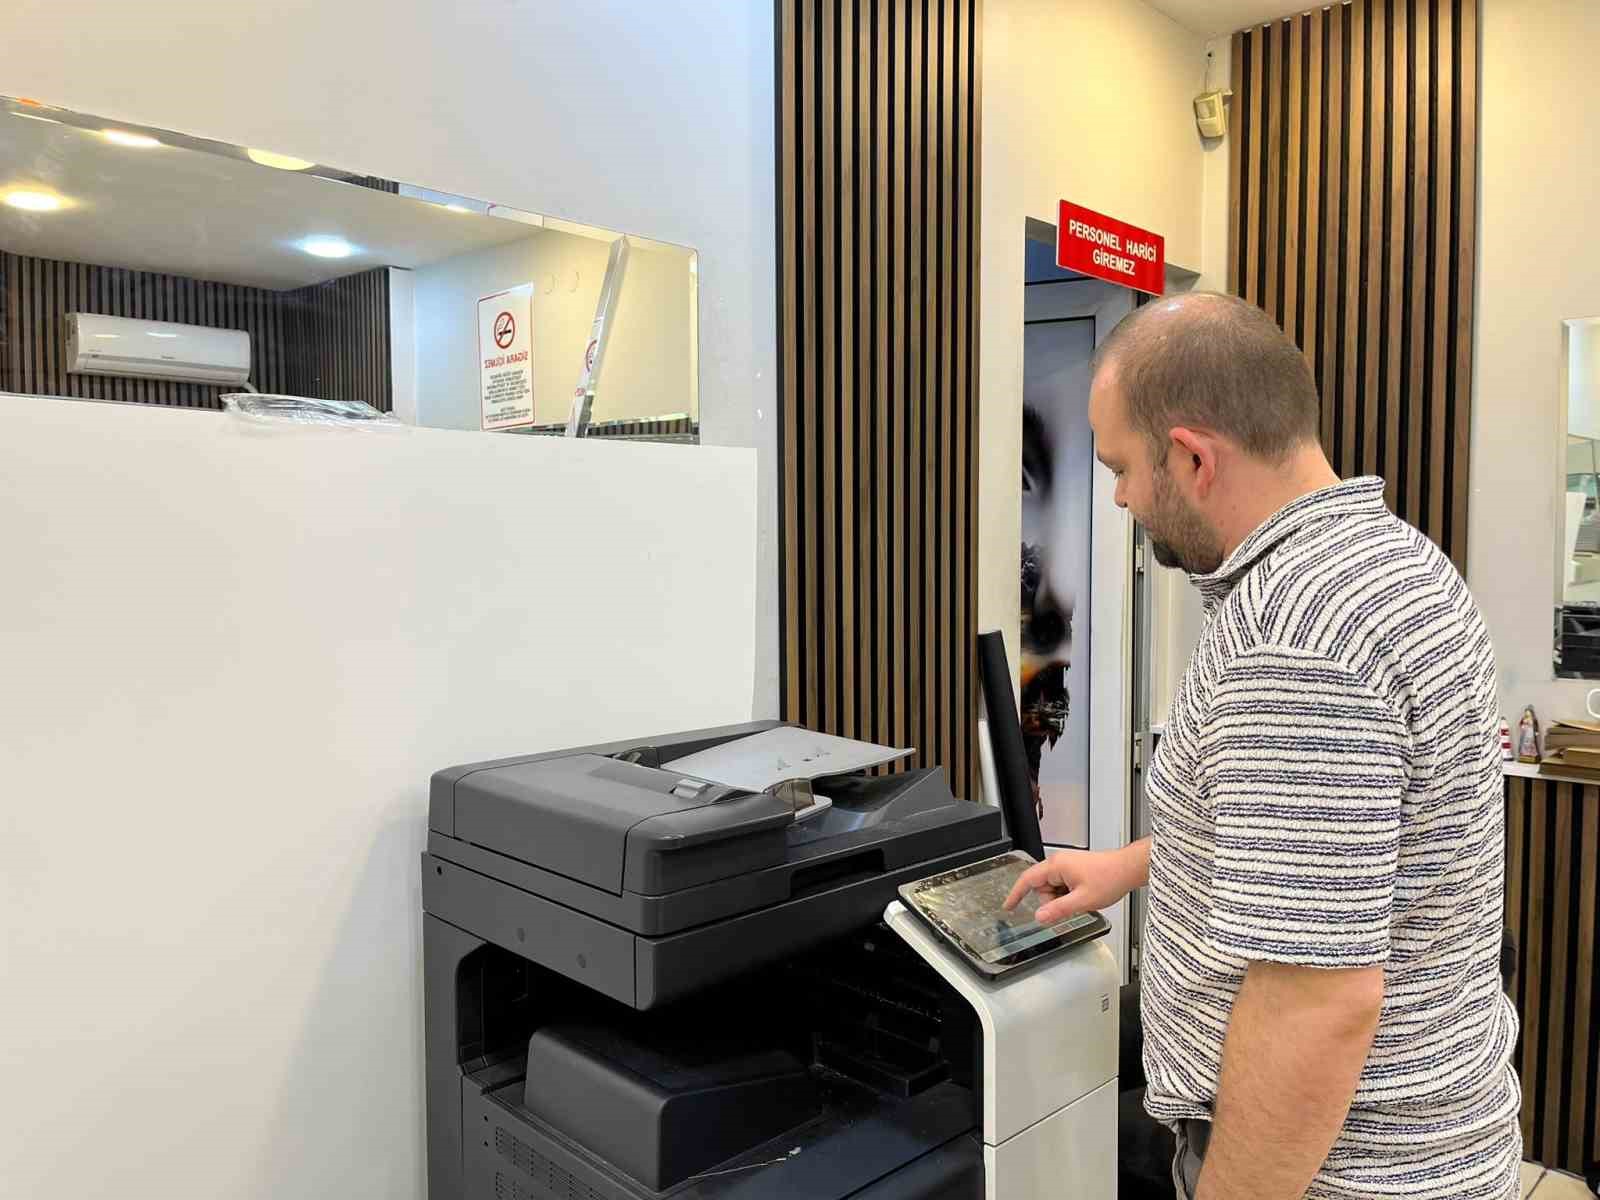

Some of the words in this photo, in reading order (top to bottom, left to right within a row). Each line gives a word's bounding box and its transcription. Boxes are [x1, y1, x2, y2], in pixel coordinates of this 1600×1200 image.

[1069, 219, 1122, 251] PERSONEL
[1126, 239, 1157, 262] HARİCİ
[1092, 247, 1136, 276] GİREMEZ
